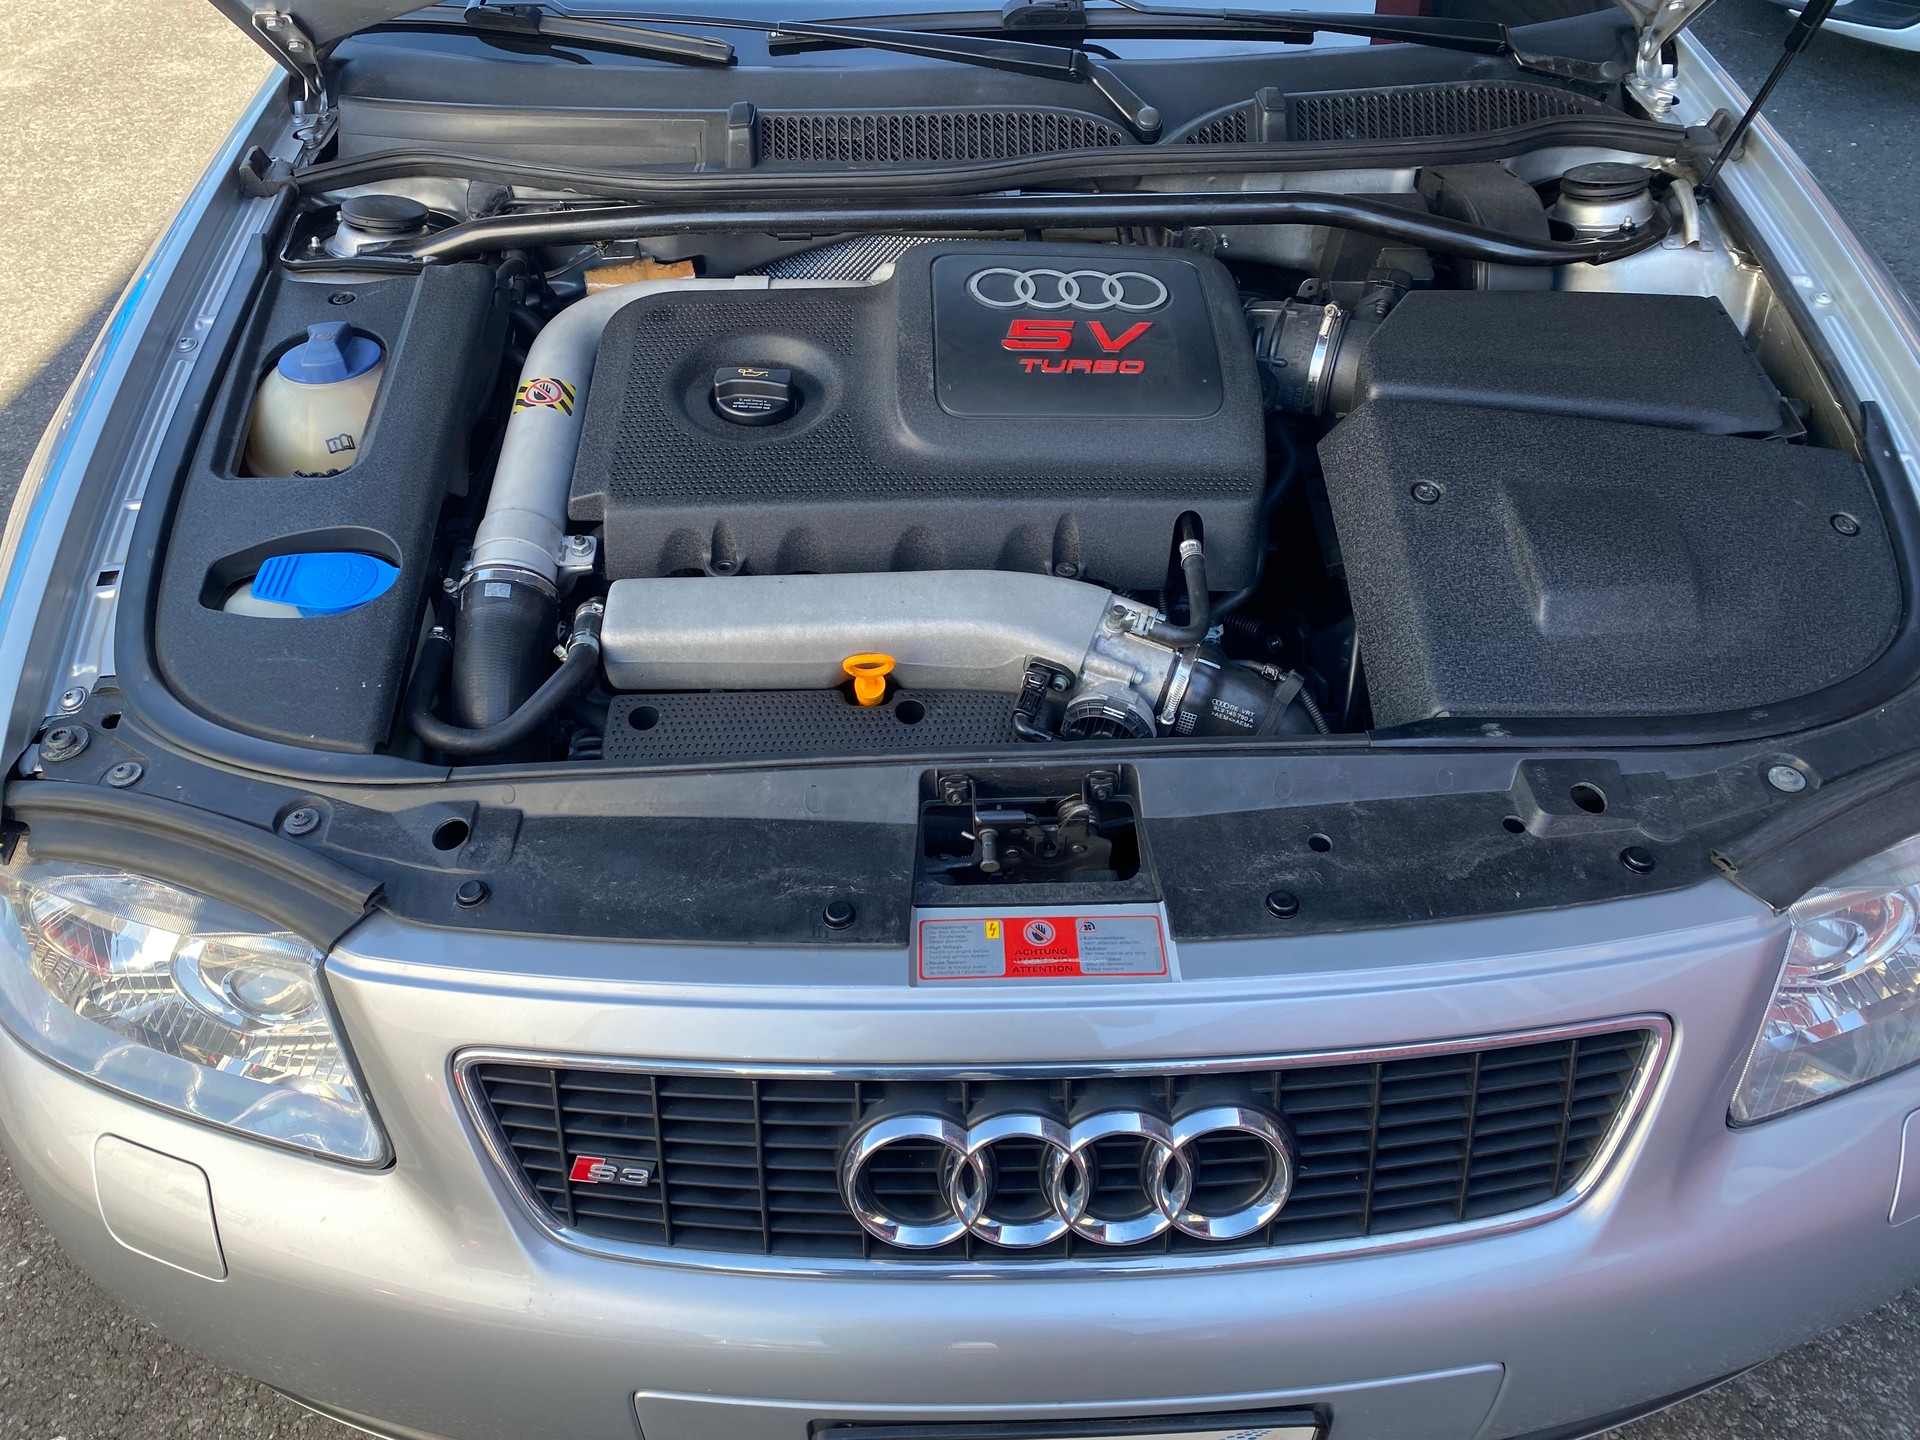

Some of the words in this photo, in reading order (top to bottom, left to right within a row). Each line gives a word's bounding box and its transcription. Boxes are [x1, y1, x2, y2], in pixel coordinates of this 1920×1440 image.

[1018, 358, 1145, 375] TURBO
[1012, 965, 1073, 973] ATTENTION
[587, 1163, 650, 1187] S3
